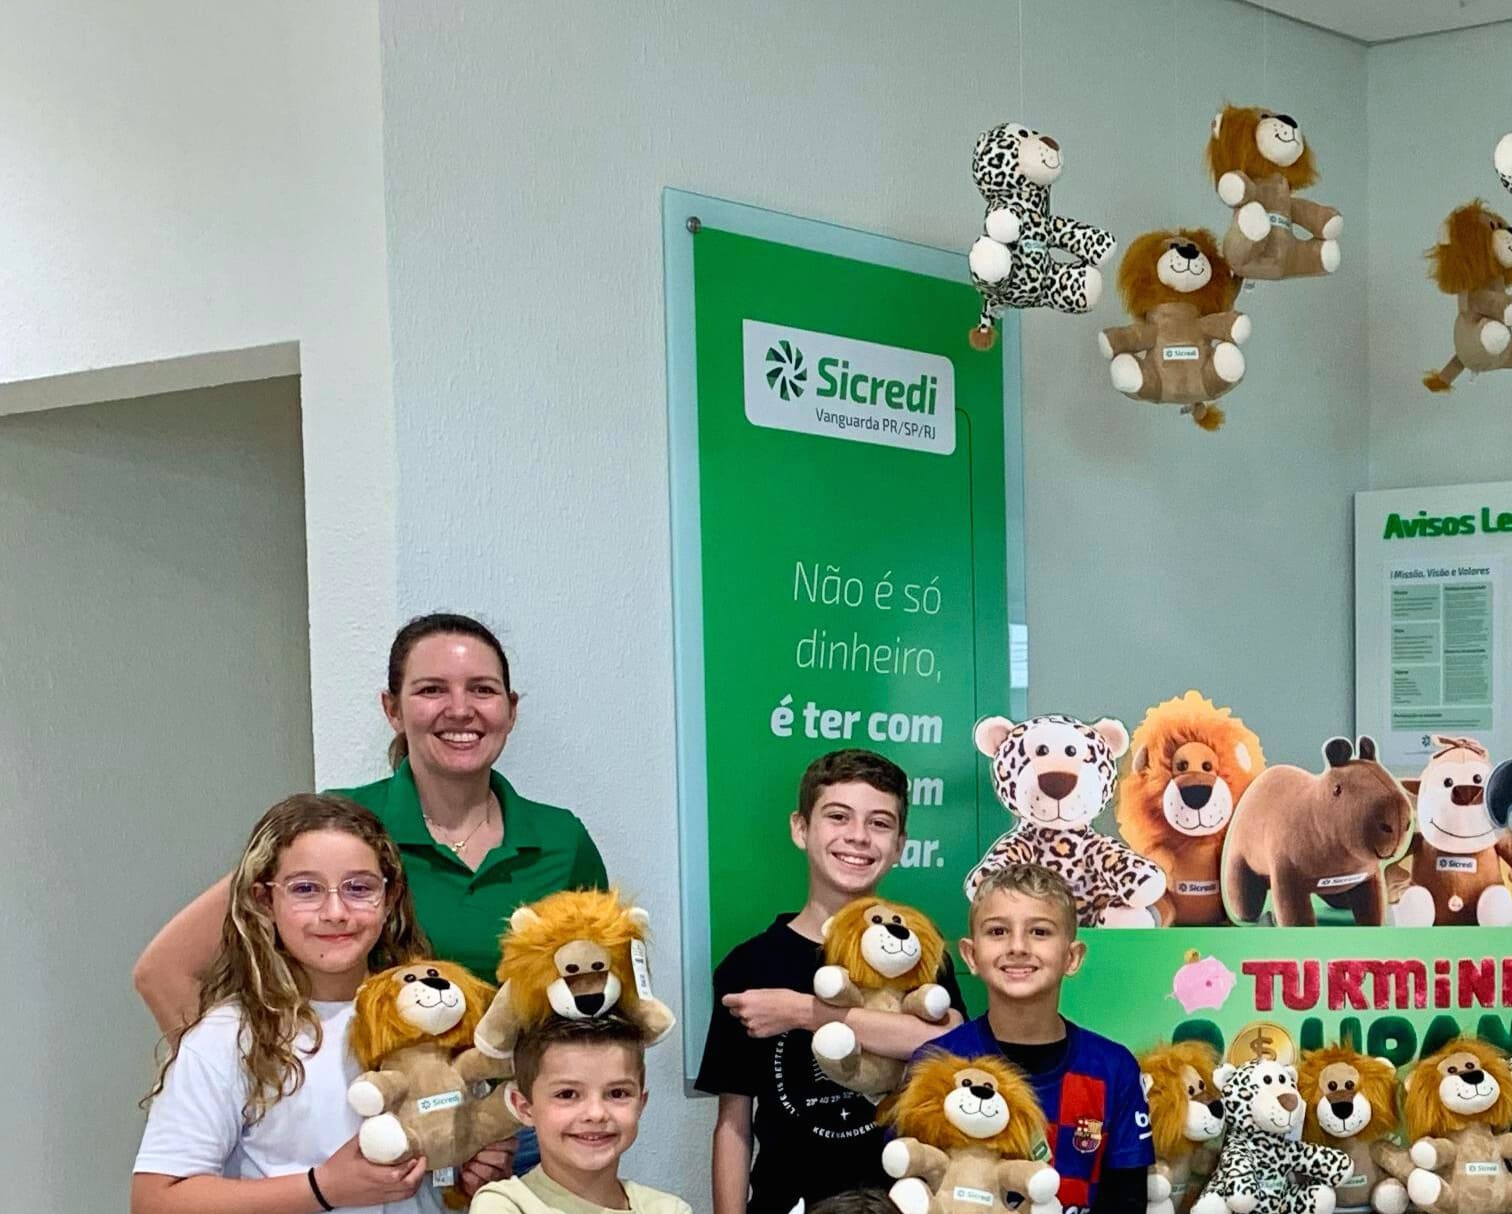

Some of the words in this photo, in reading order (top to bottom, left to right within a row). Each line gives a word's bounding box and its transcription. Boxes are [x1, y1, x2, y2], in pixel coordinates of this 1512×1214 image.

[816, 357, 938, 415] Sicredi
[816, 408, 880, 430] Vanguarda
[882, 418, 936, 440] PR/SP/RJ
[1383, 510, 1475, 539] Avisos
[794, 561, 864, 607] Não
[875, 570, 892, 610] é
[903, 575, 942, 615] só
[796, 629, 942, 682] dinheiro,
[771, 694, 793, 737] é
[803, 702, 861, 740] ter
[867, 712, 943, 744] com
[1448, 860, 1473, 868] Sicredi
[1188, 884, 1217, 892] Sicredi
